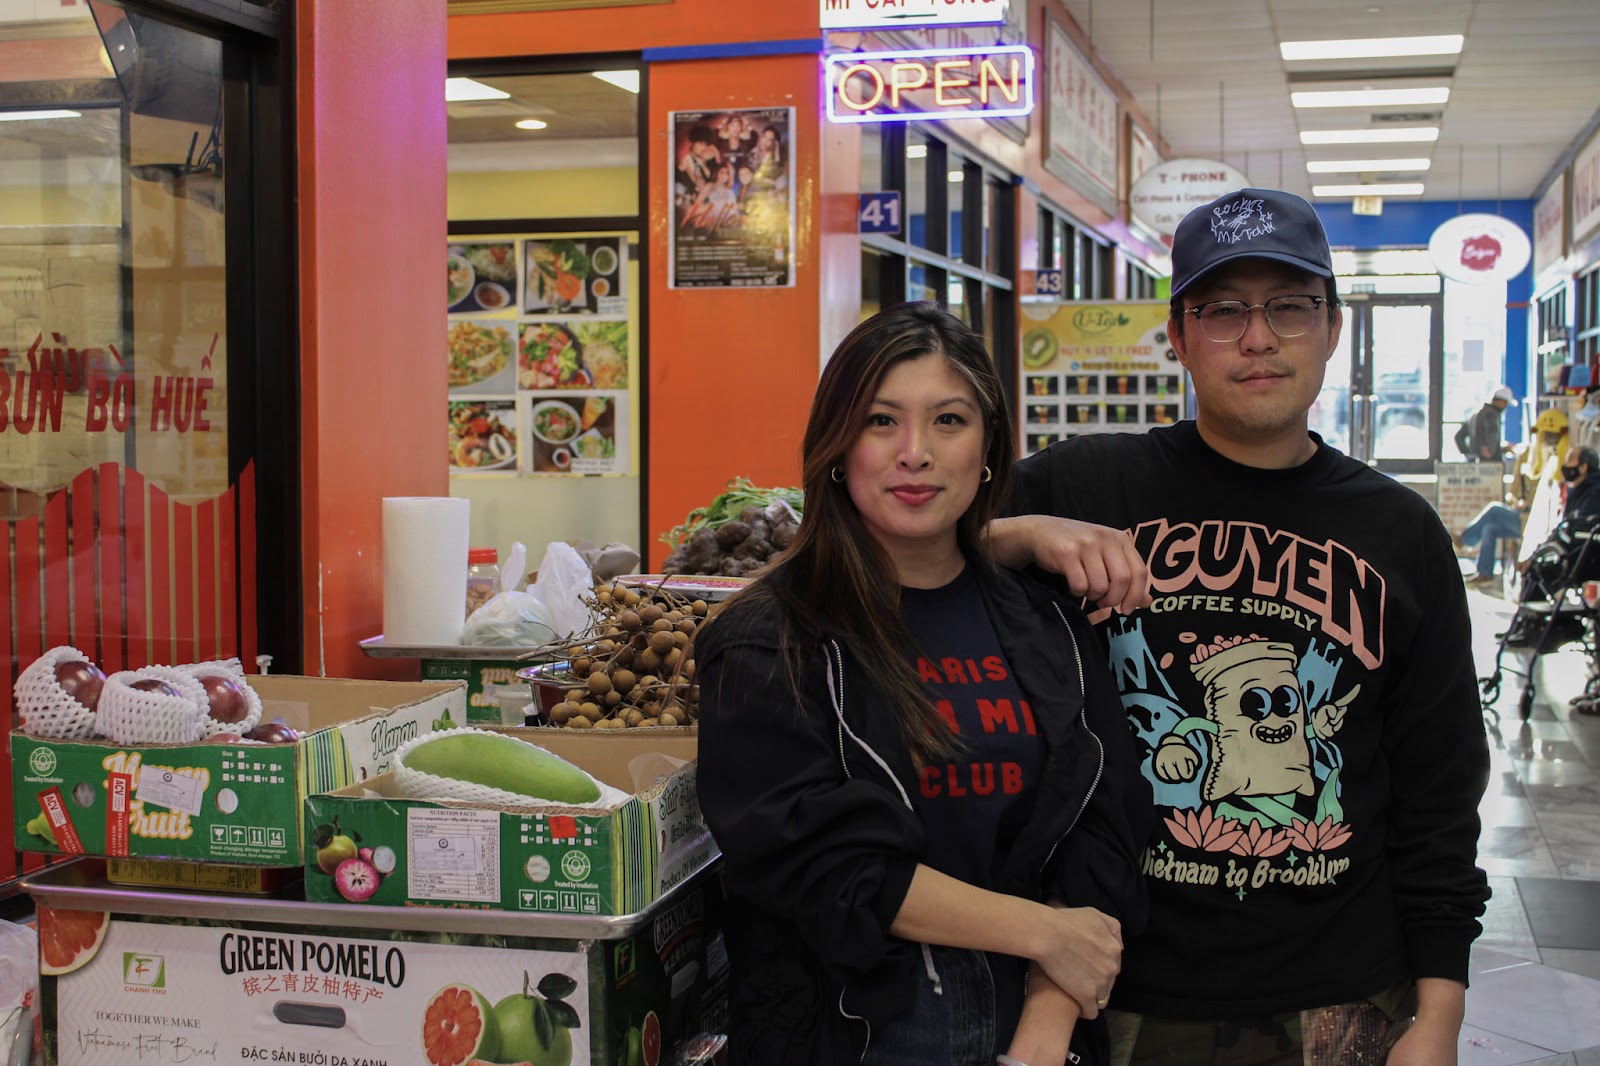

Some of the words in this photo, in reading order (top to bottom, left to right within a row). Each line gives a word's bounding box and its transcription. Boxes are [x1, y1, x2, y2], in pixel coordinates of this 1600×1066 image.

[838, 58, 1019, 111] OPEN
[1181, 171, 1227, 183] PHONE
[860, 199, 899, 228] 41
[1037, 273, 1062, 291] 43
[85, 343, 134, 433] BÒ
[150, 332, 219, 433] HUẾ
[1151, 594, 1235, 613] COFFEE
[1240, 597, 1318, 632] SUPPLY
[115, 779, 124, 796] ACV
[919, 761, 1023, 799] CLUB
[45, 795, 59, 811] ACV
[270, 832, 282, 840] 14
[1224, 859, 1248, 887] to
[554, 880, 570, 888] Treated
[570, 881, 576, 889] by
[584, 897, 596, 905] 14
[220, 932, 295, 976] GREEN
[301, 940, 405, 989] POMELO
[95, 1011, 151, 1024] TOGETHER
[153, 1016, 169, 1026] WE
[171, 1017, 201, 1028] MAKE
